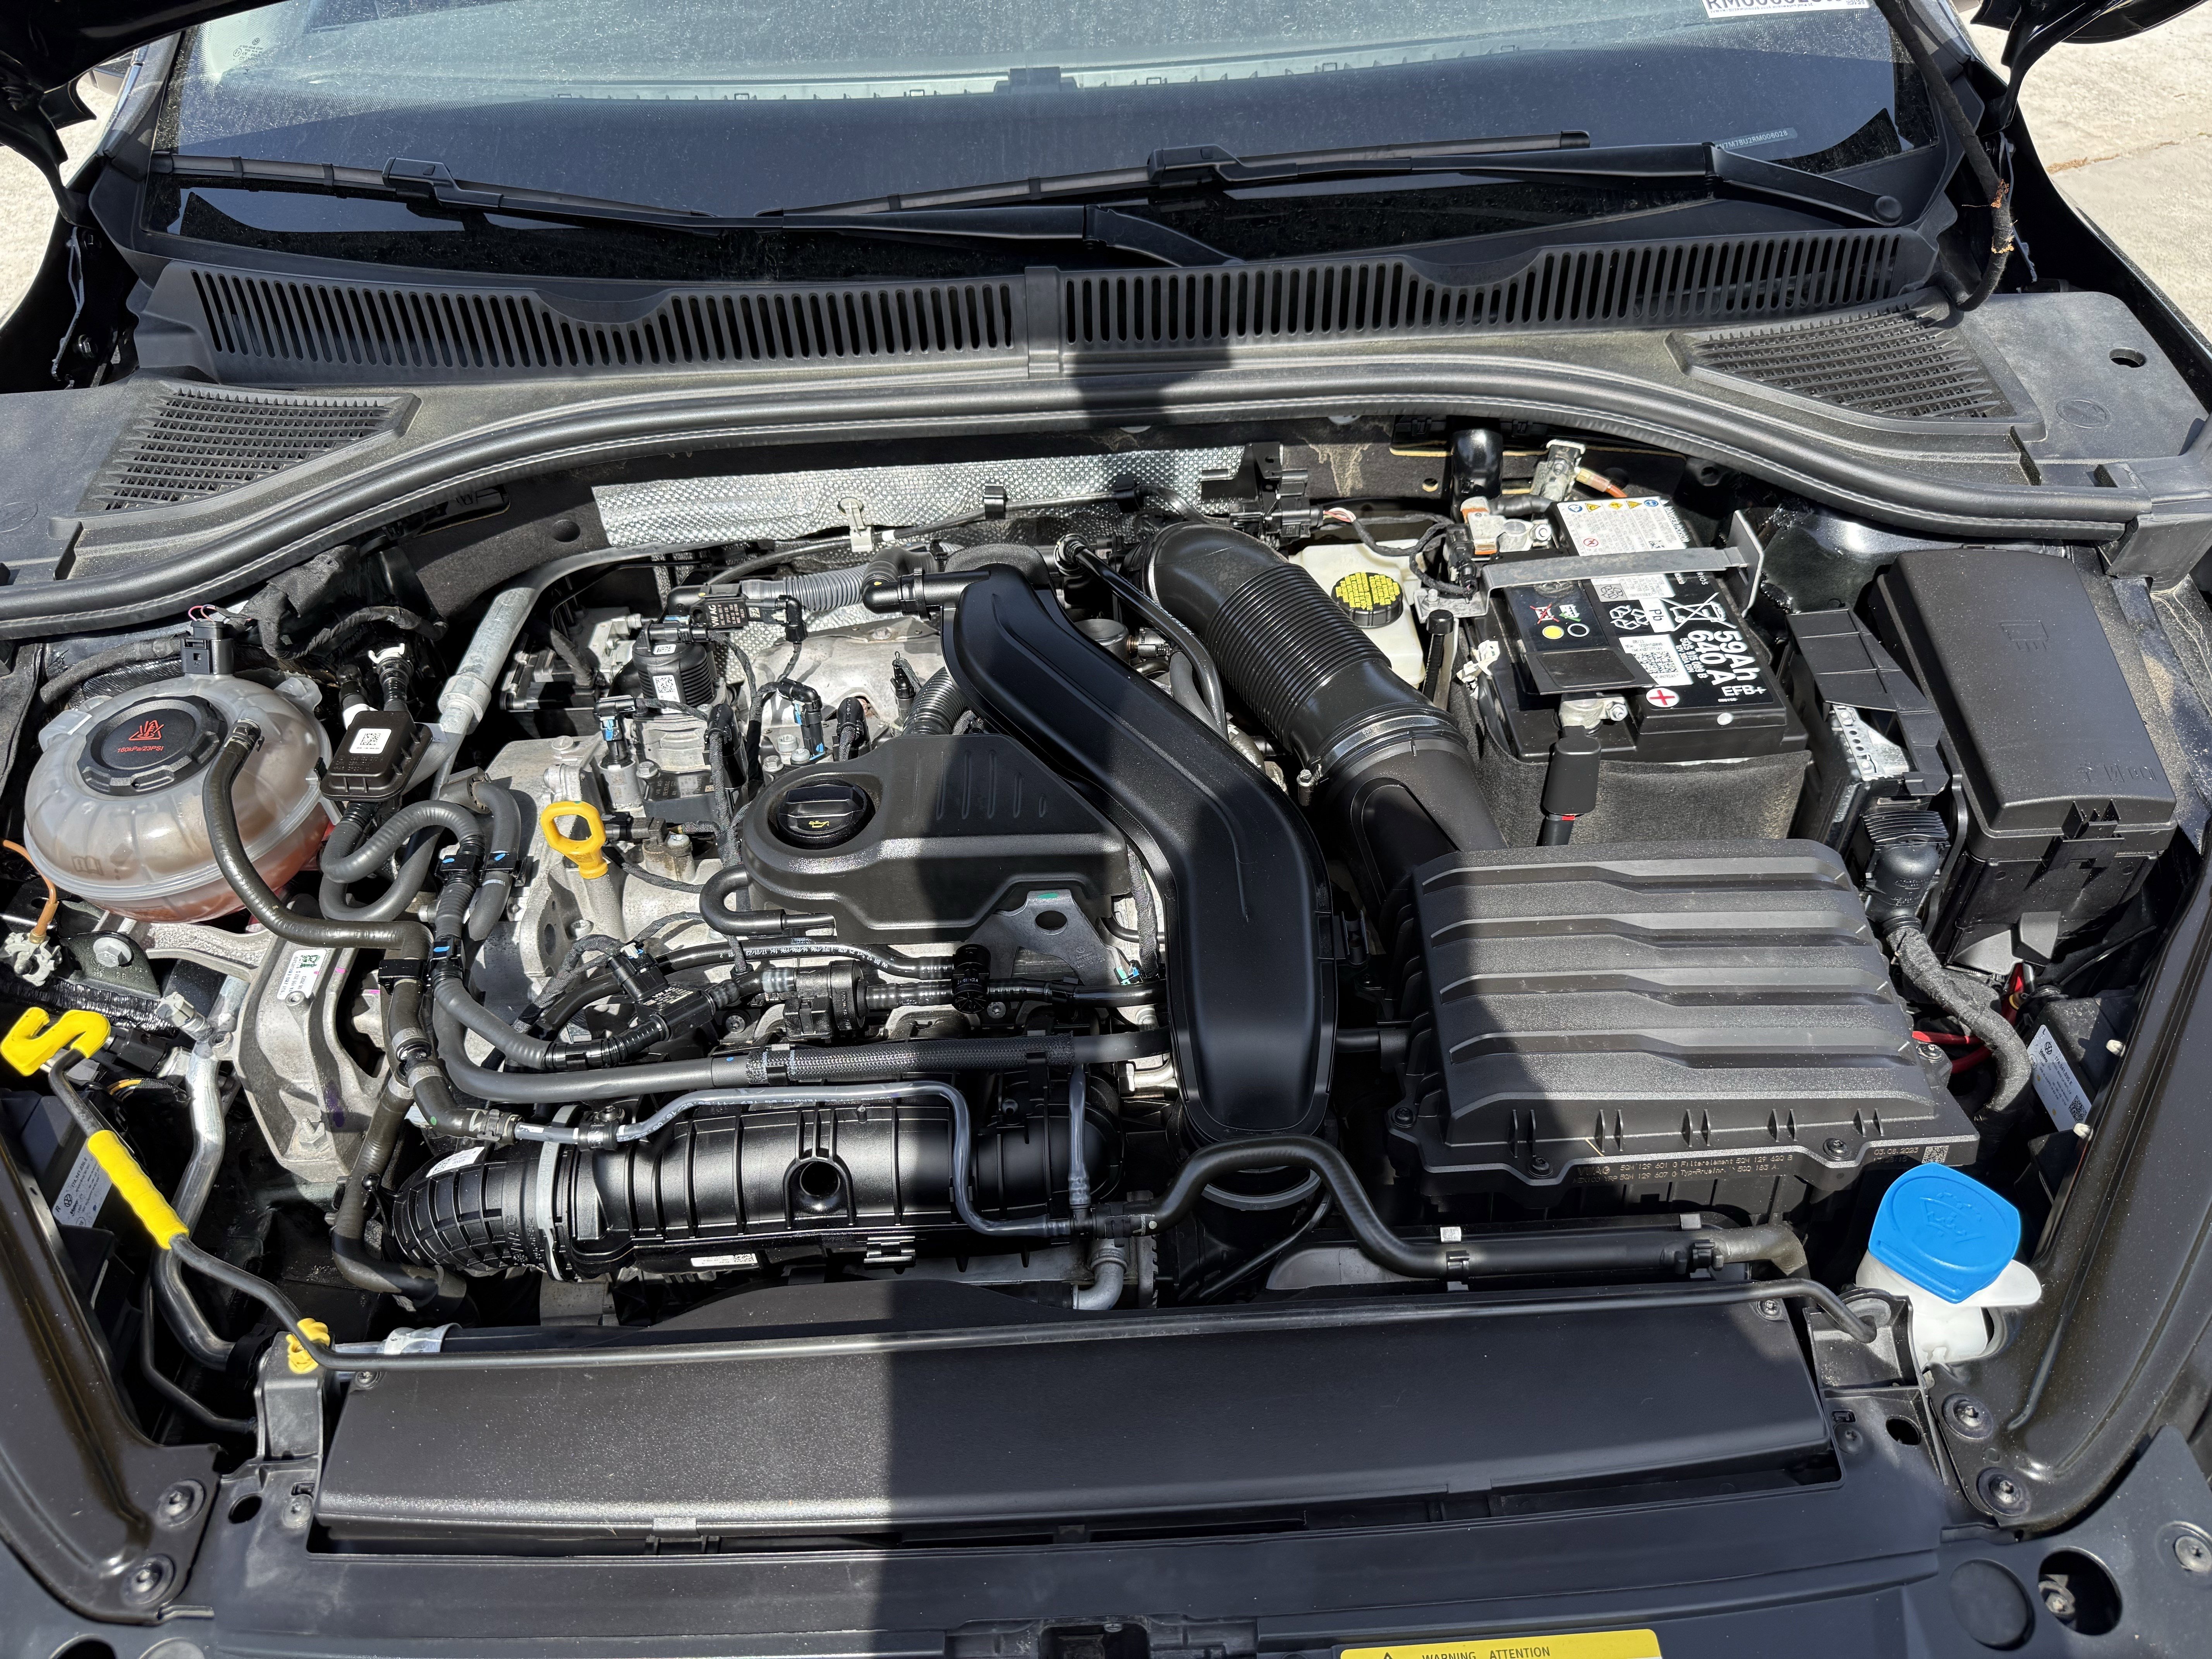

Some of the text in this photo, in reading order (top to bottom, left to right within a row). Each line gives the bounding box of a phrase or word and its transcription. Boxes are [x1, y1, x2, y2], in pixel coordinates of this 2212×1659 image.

[1715, 130, 1788, 149] 7M7BU2RM006028
[1697, 572, 1709, 585] RIOS
[1649, 609, 1662, 621] Pb
[1688, 630, 1727, 665] 640
[1714, 630, 1761, 681] 59Ah
[1706, 669, 1736, 685] A
[1721, 685, 1767, 696] EFB+
[1490, 1646, 1550, 1659] ATTENTION
